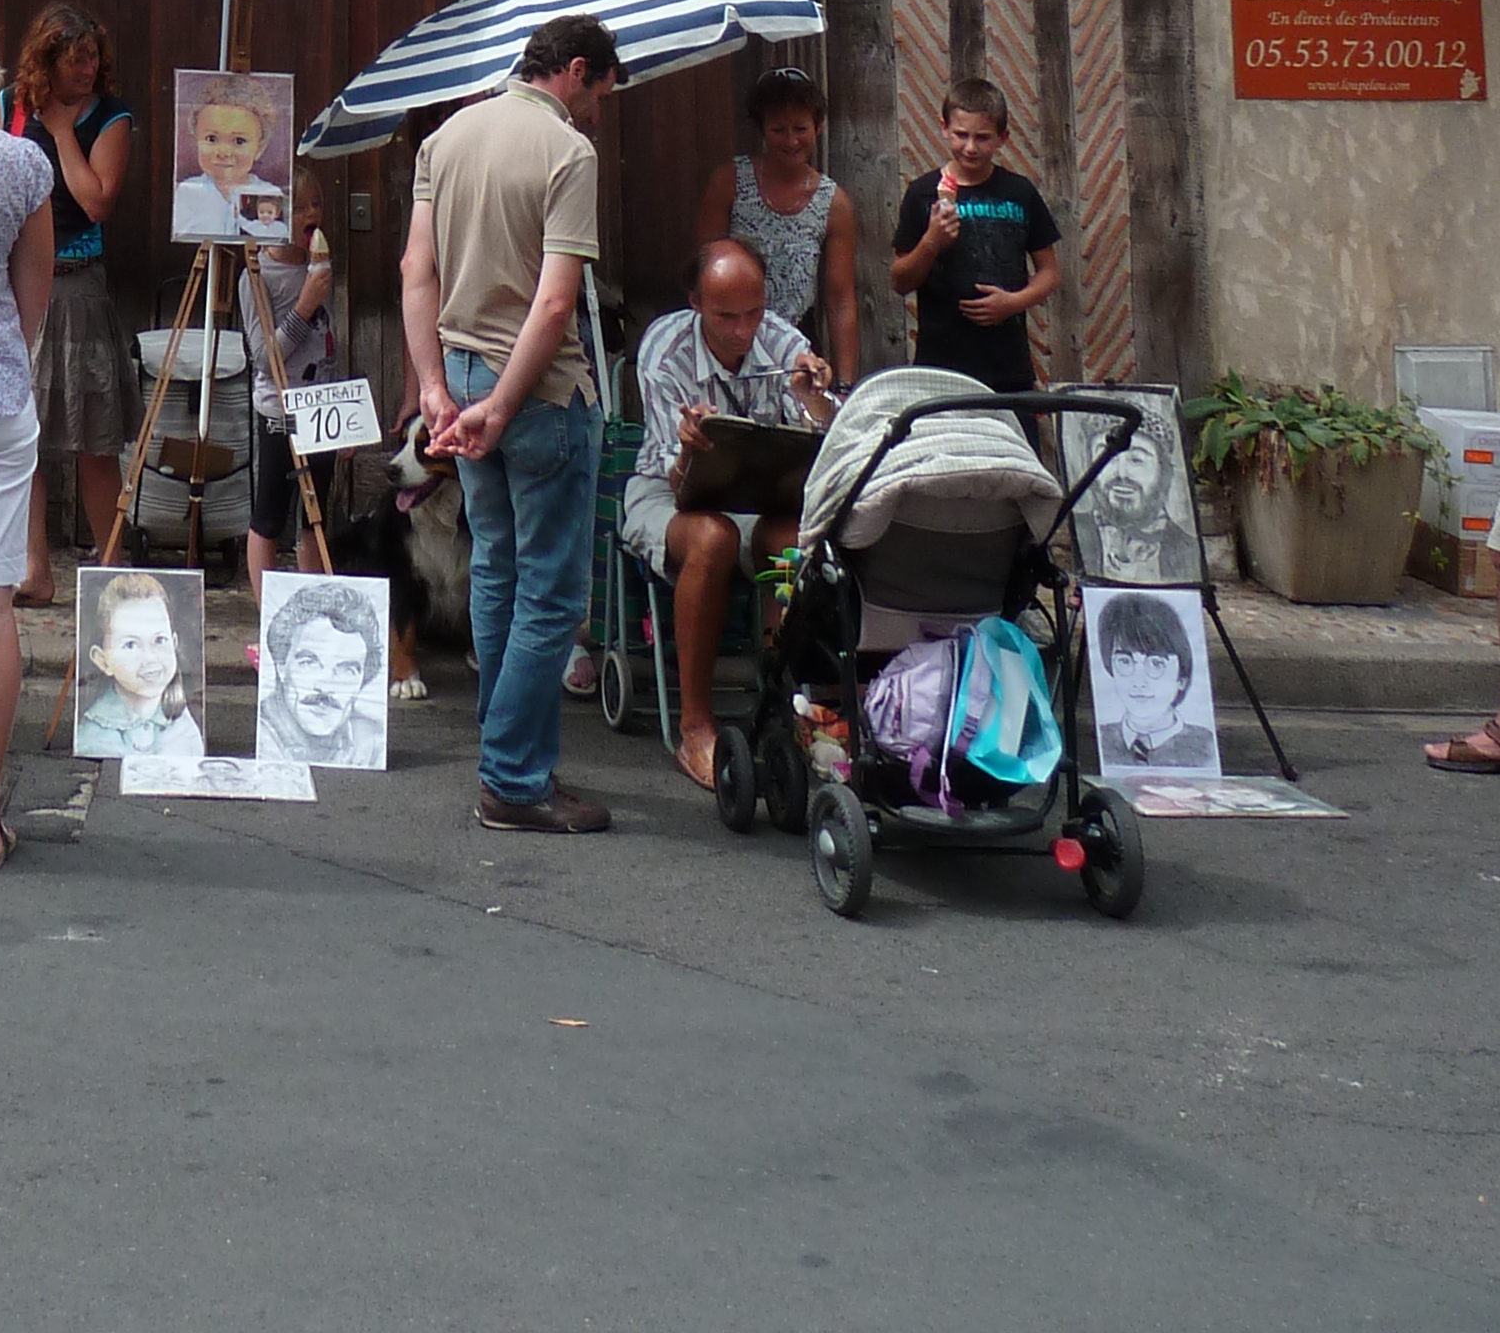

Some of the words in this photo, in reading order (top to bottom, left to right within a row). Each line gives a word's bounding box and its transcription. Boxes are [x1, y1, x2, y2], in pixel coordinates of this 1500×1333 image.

[1268, 11, 1290, 26] En
[1294, 10, 1331, 26] direct
[1336, 10, 1357, 26] des
[1360, 10, 1441, 26] Producteurs
[1245, 39, 1468, 69] 05.53.73.00.12
[1307, 78, 1411, 94] www.loupelou.com
